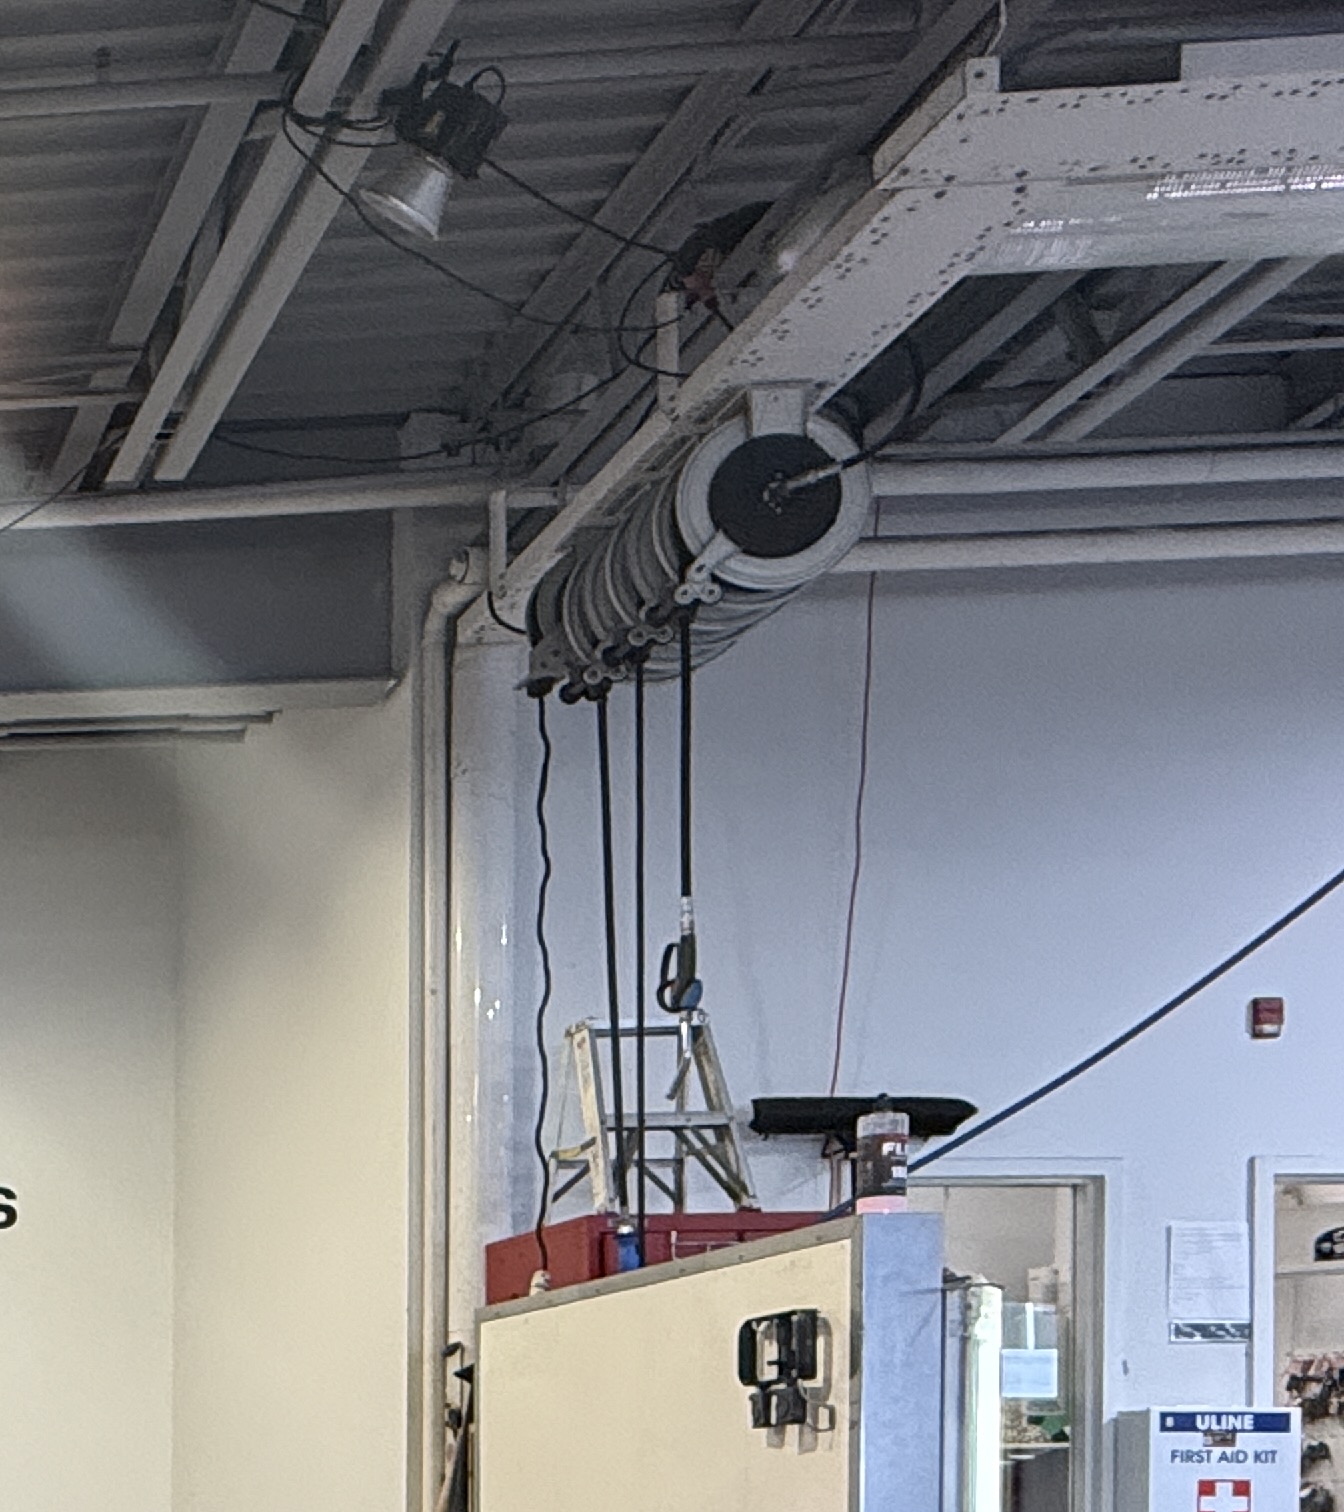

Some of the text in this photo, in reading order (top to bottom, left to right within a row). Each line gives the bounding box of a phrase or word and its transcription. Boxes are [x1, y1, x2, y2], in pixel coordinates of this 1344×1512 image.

[1195, 1414, 1255, 1430] ULINE
[1170, 1449, 1278, 1464] FIRST AID KIT
